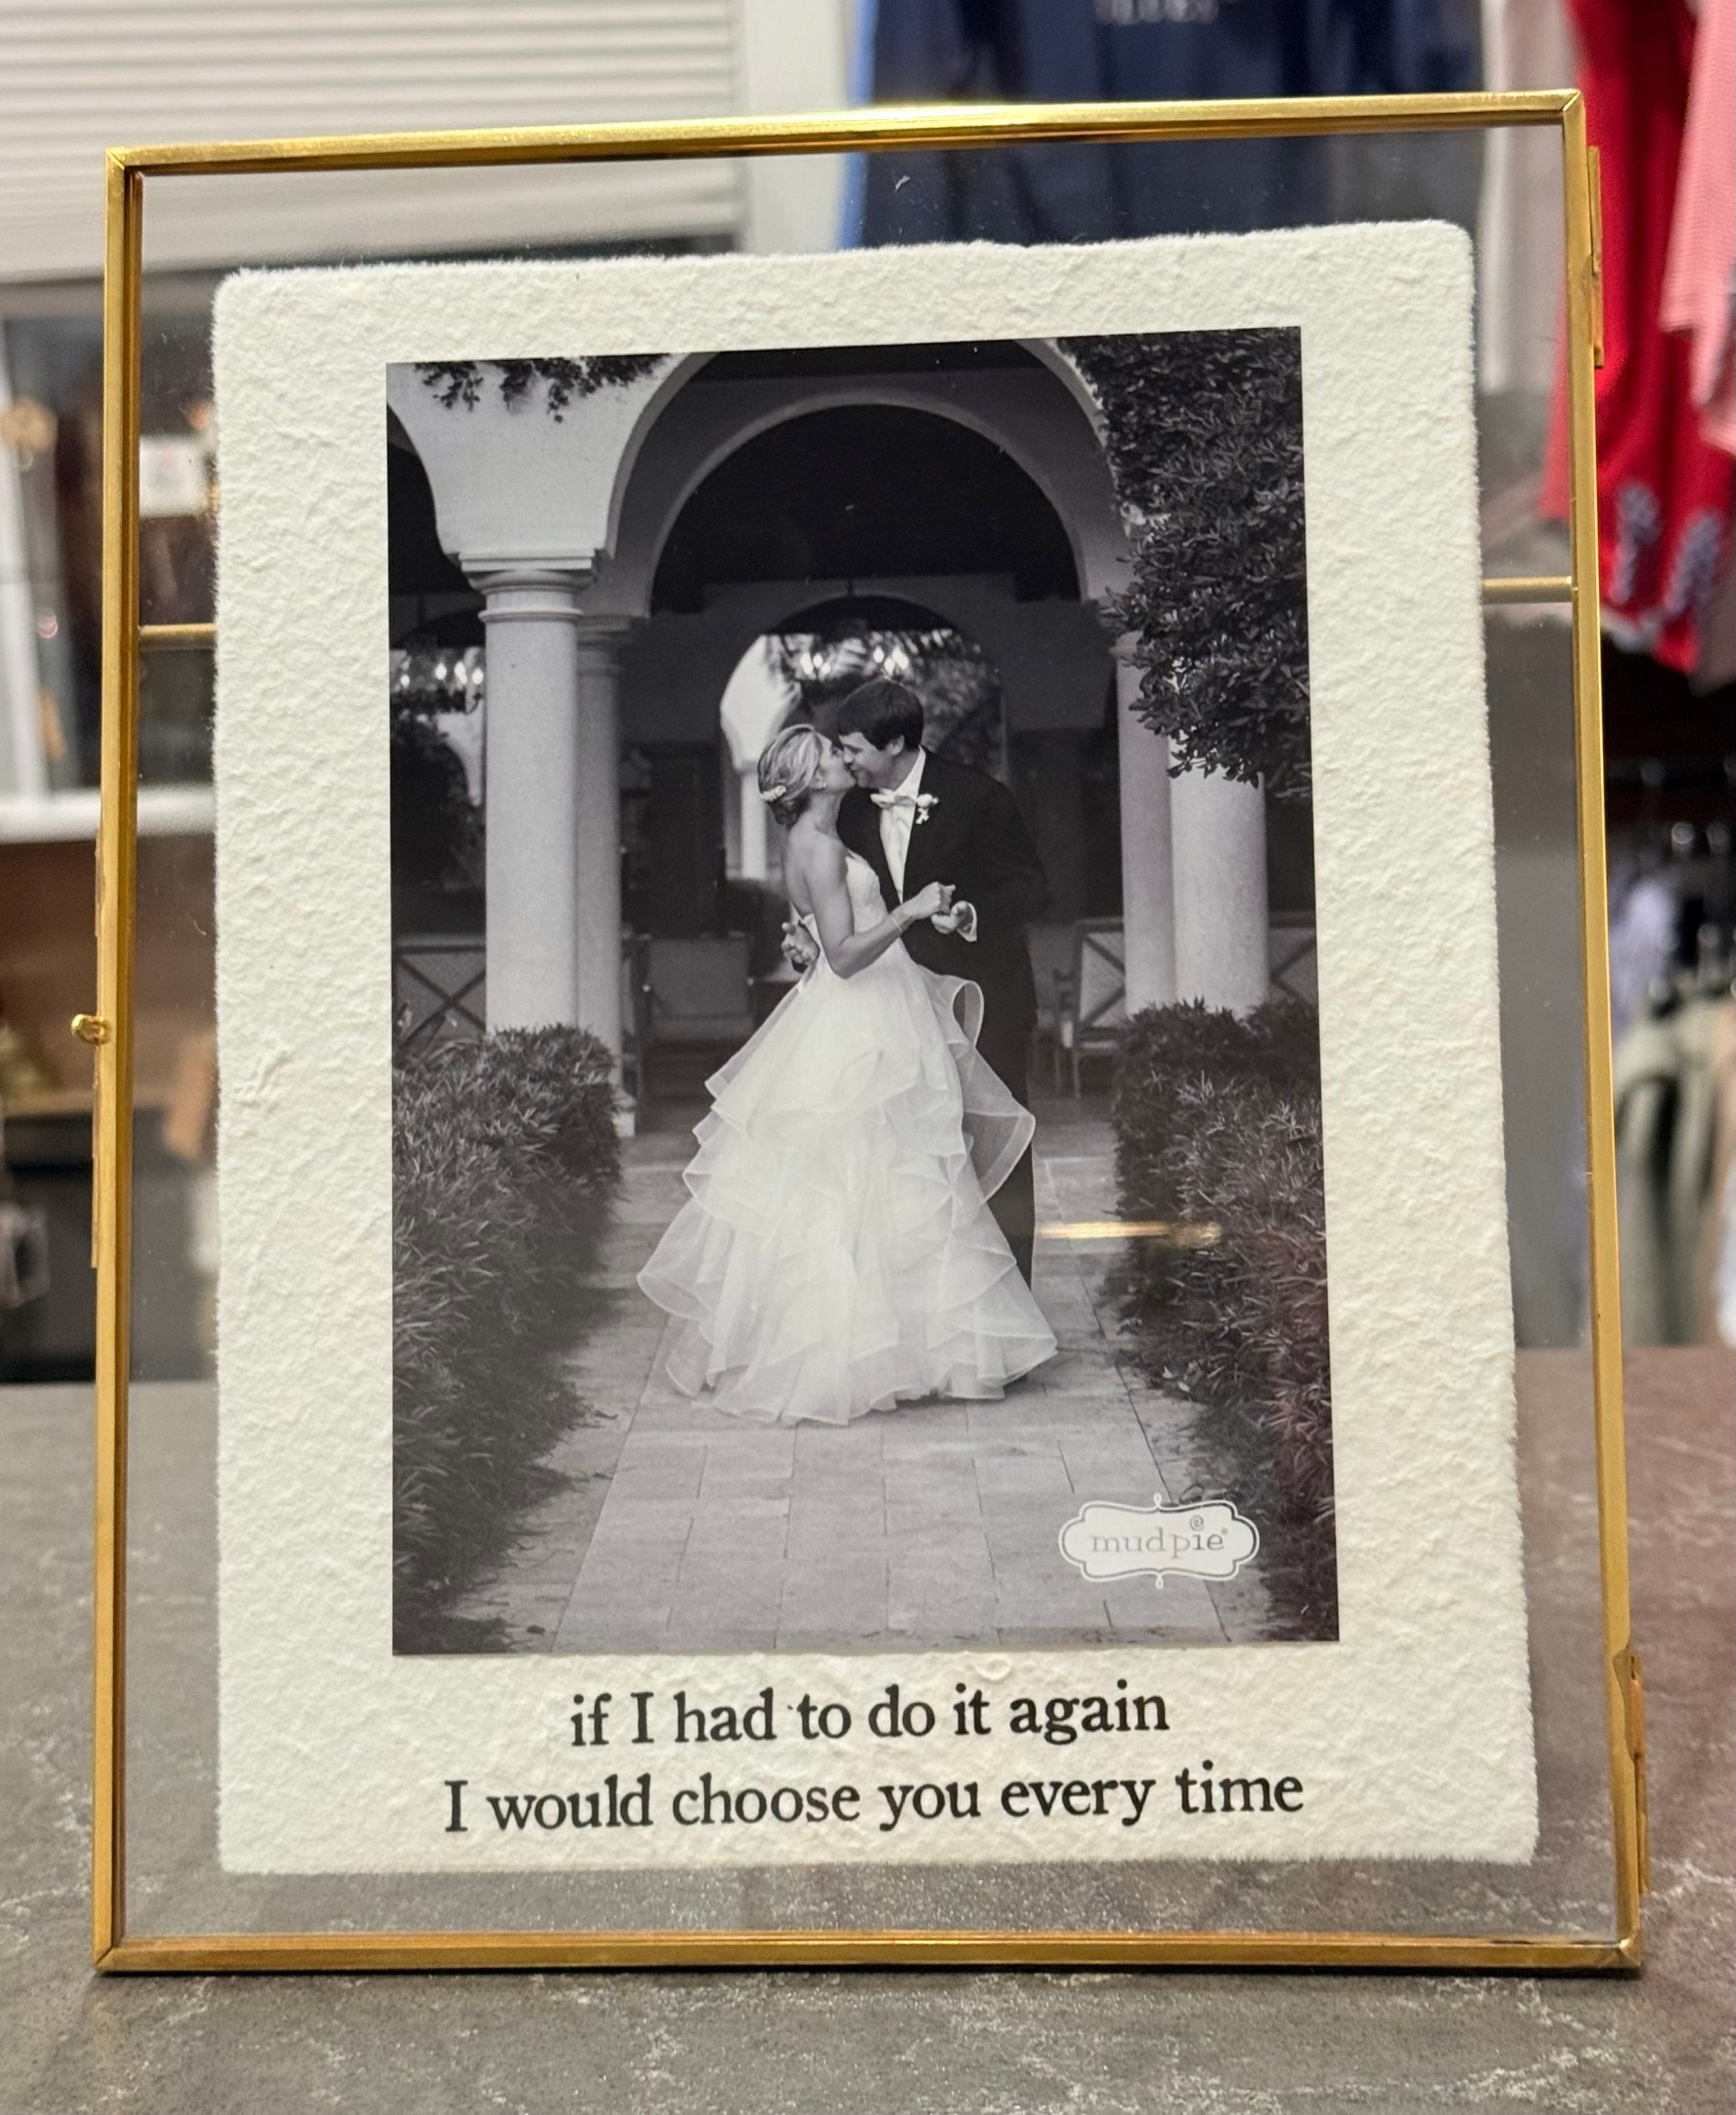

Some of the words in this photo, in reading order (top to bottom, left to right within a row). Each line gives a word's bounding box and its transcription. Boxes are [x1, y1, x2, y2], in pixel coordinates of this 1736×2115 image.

[570, 1693, 612, 1747] if
[630, 1691, 655, 1743] I
[673, 1686, 777, 1743] had
[796, 1694, 852, 1740] to
[868, 1683, 935, 1738] do
[953, 1682, 992, 1736] it
[1009, 1678, 1170, 1746] again
[444, 1780, 469, 1832] I
[486, 1772, 653, 1831] would
[672, 1772, 860, 1826] choose
[878, 1782, 981, 1832] you
[1001, 1779, 1156, 1827] every
[1175, 1759, 1304, 1814] time
